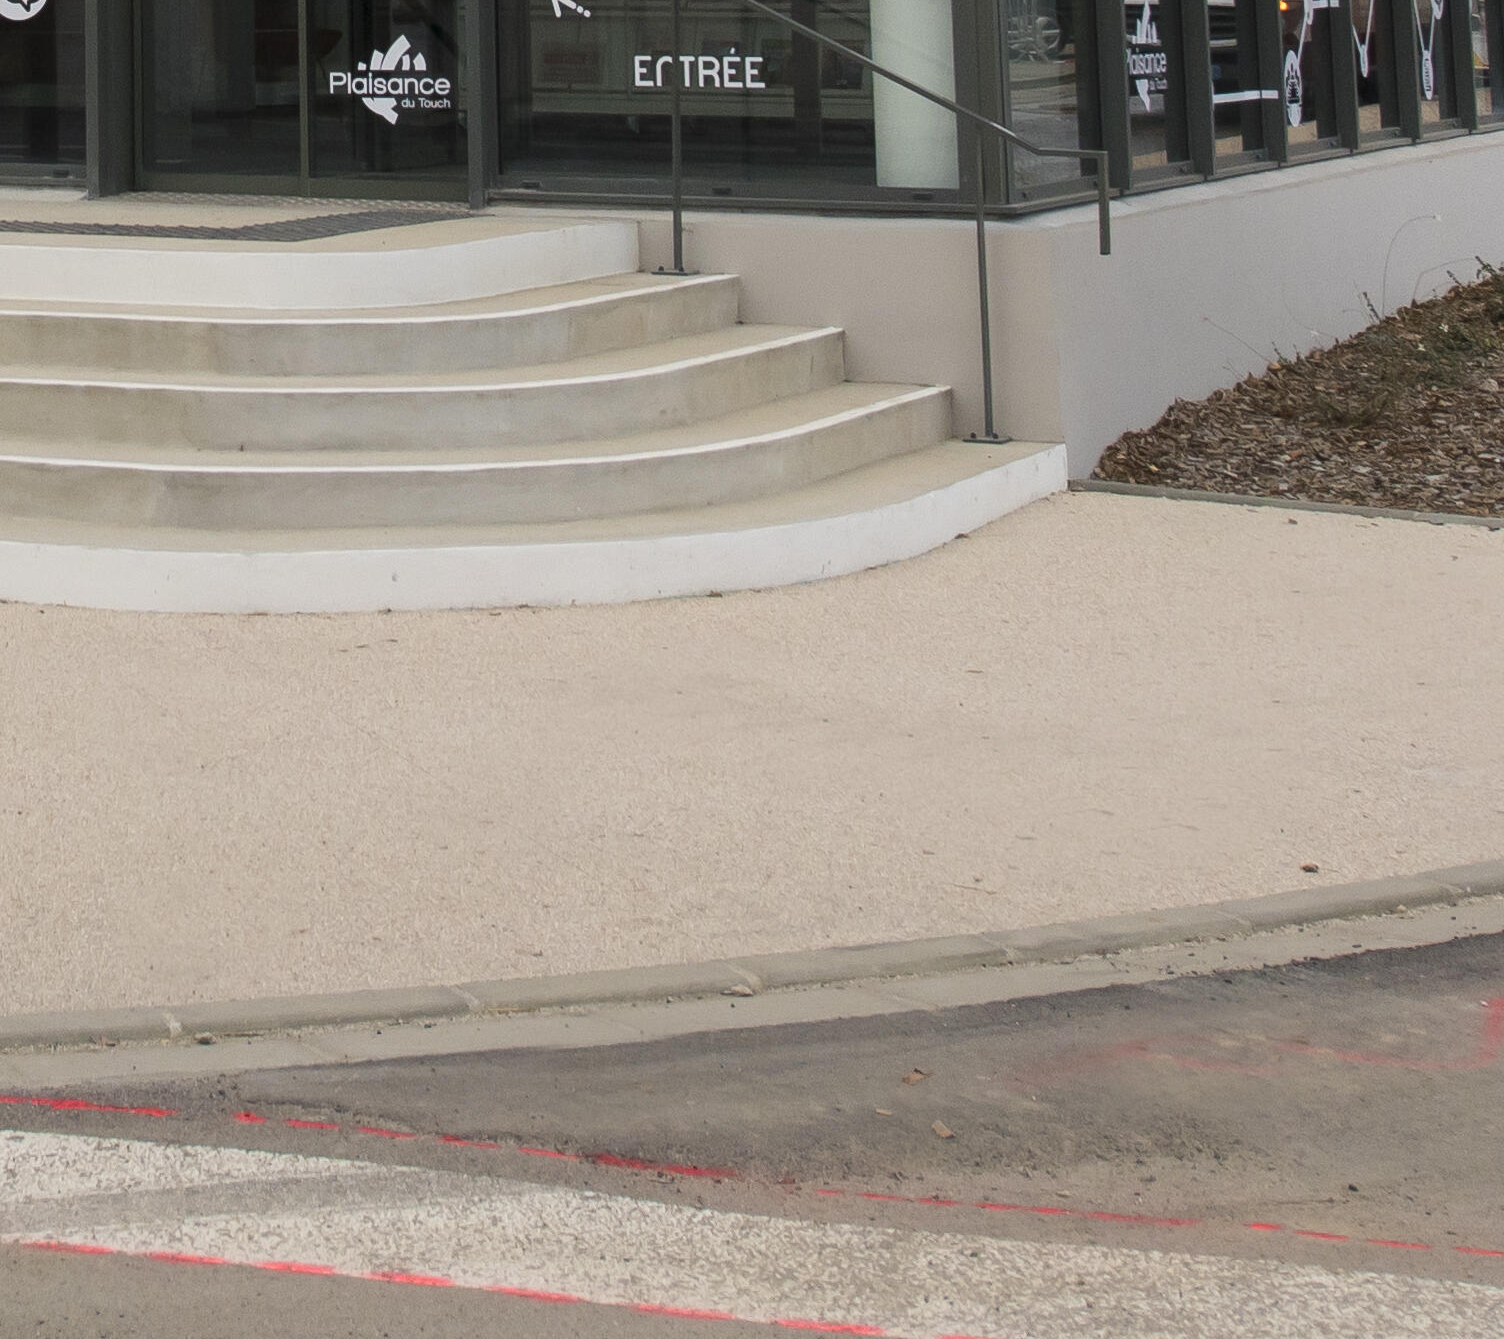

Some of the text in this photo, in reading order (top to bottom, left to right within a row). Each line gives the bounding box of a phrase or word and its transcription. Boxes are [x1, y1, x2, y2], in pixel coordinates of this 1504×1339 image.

[329, 72, 451, 95] Plaisance
[401, 97, 451, 108] du Touch
